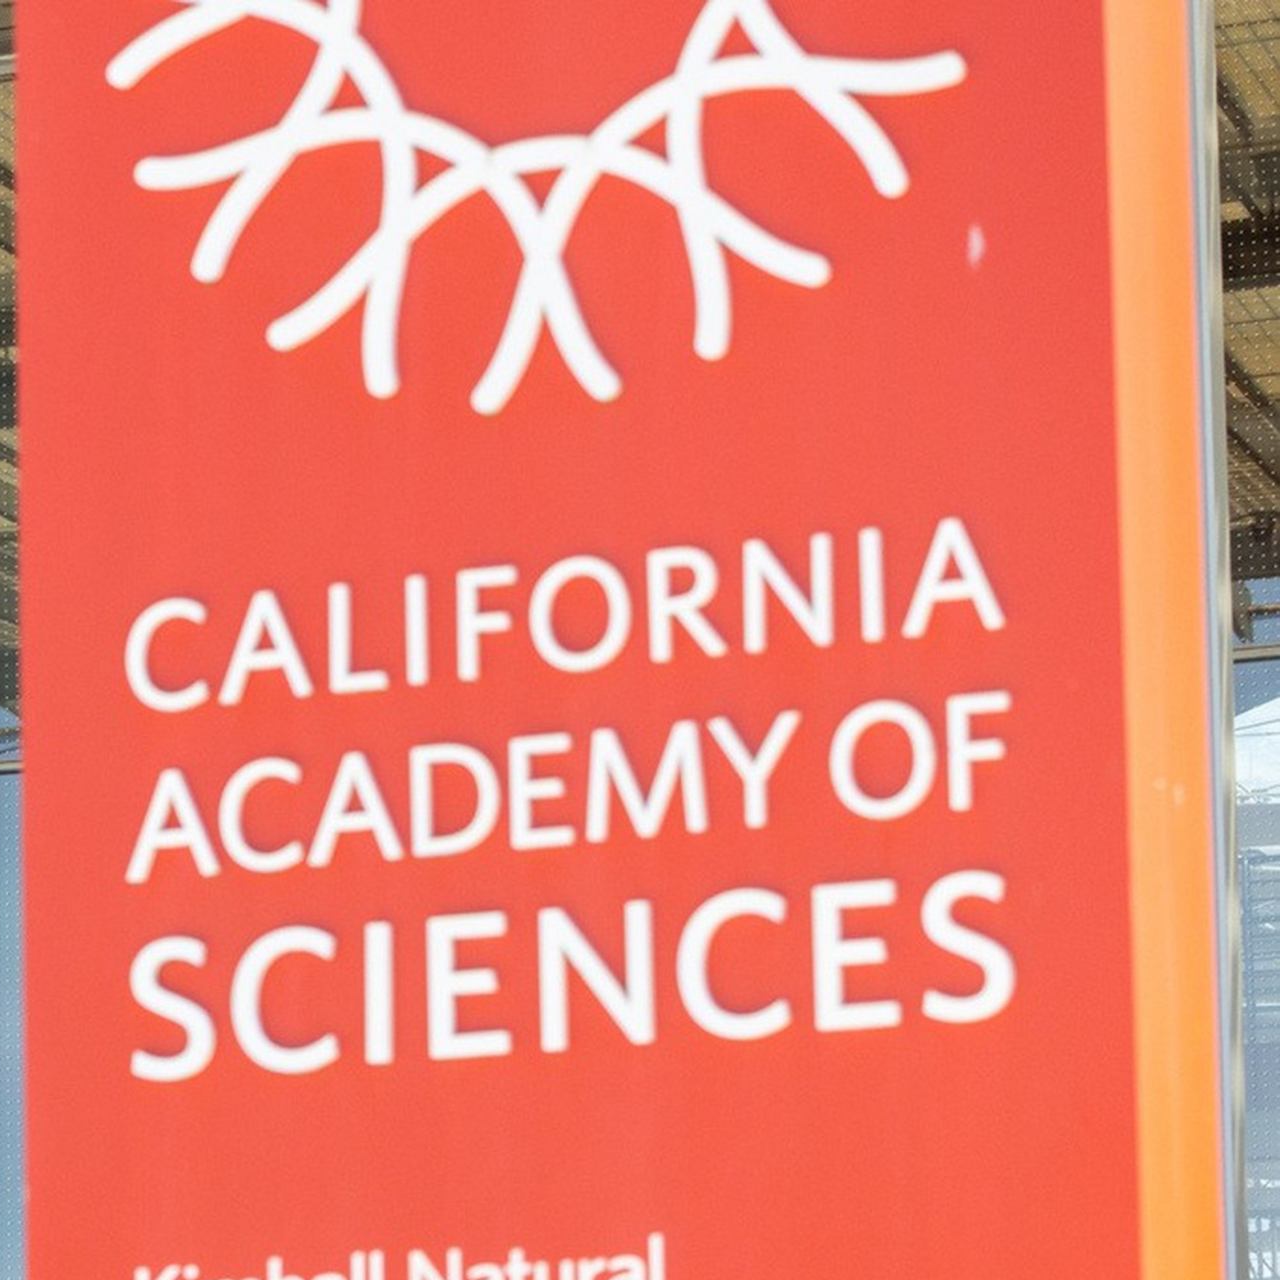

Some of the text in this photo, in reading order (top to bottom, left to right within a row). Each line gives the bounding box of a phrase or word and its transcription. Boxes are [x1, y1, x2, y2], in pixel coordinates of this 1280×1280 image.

[123, 516, 1006, 714] CALIFORNIA
[124, 689, 1012, 885] ACADEMY OF
[128, 869, 1017, 1083] SCIENCES
